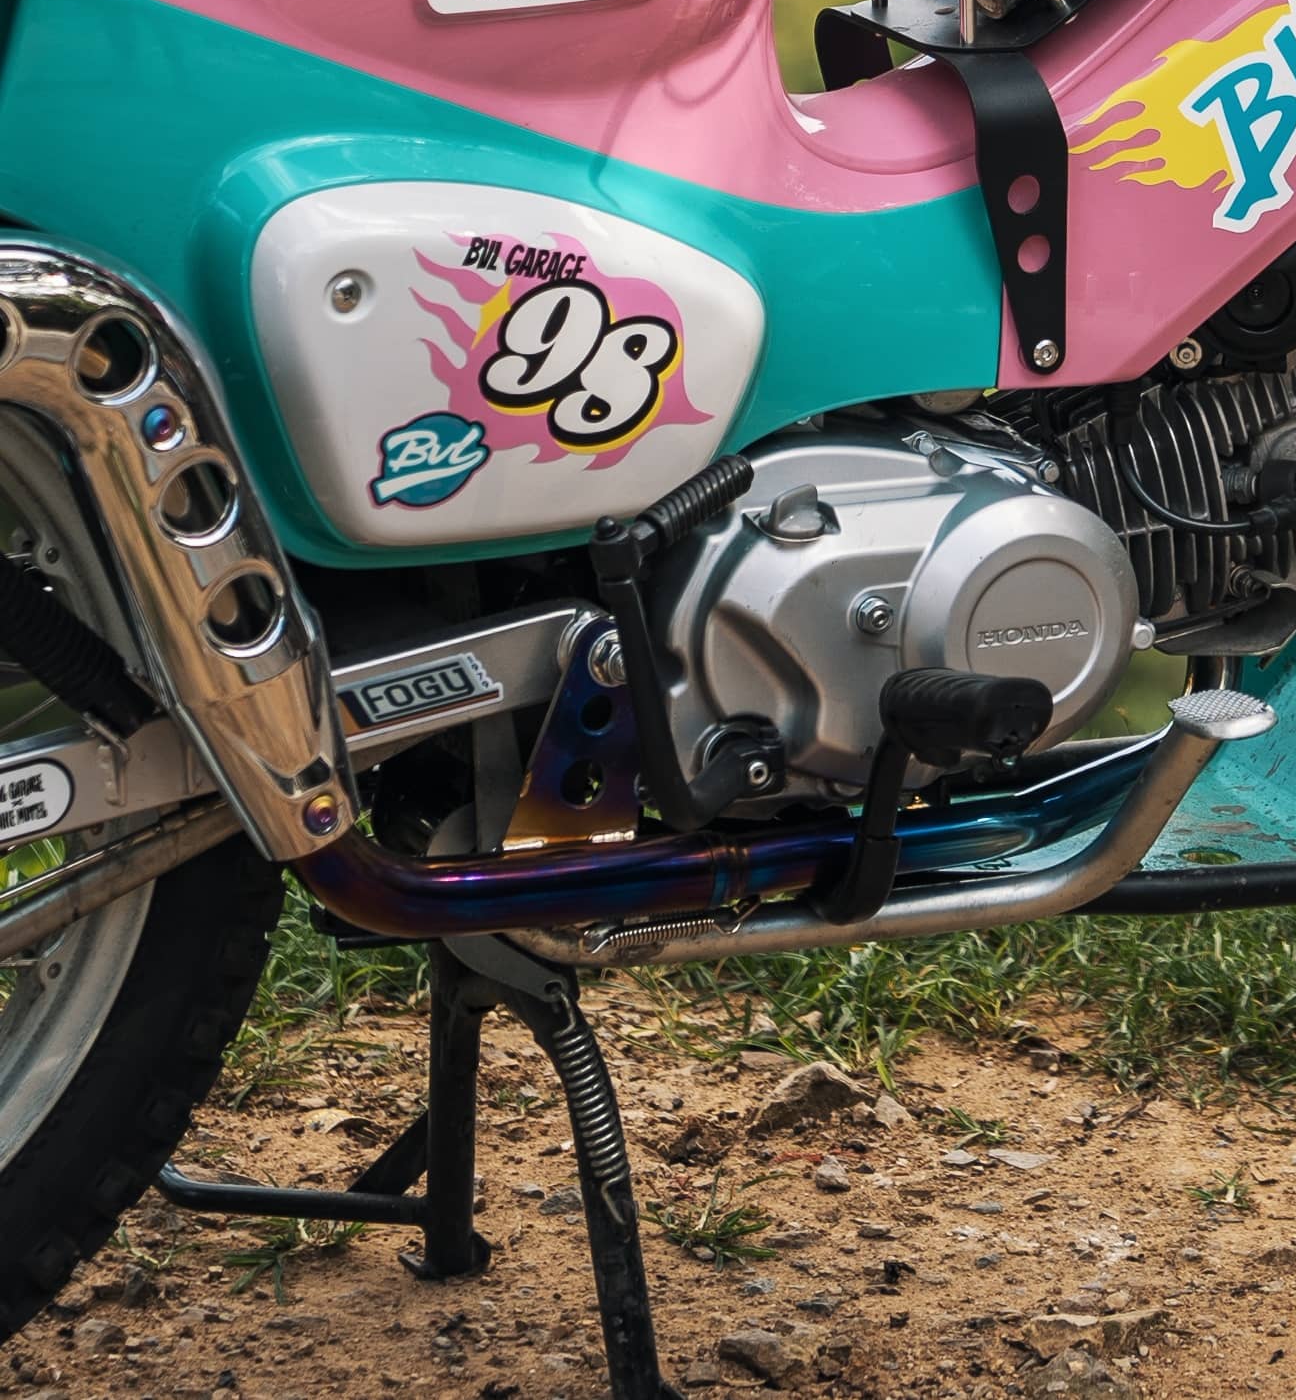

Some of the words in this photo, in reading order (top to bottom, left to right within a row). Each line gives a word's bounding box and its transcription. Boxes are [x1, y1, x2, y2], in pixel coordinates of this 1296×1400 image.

[463, 237, 503, 270] BVL
[504, 244, 587, 280] GARAGE
[481, 281, 676, 442] 98
[977, 620, 1088, 648] HONDA
